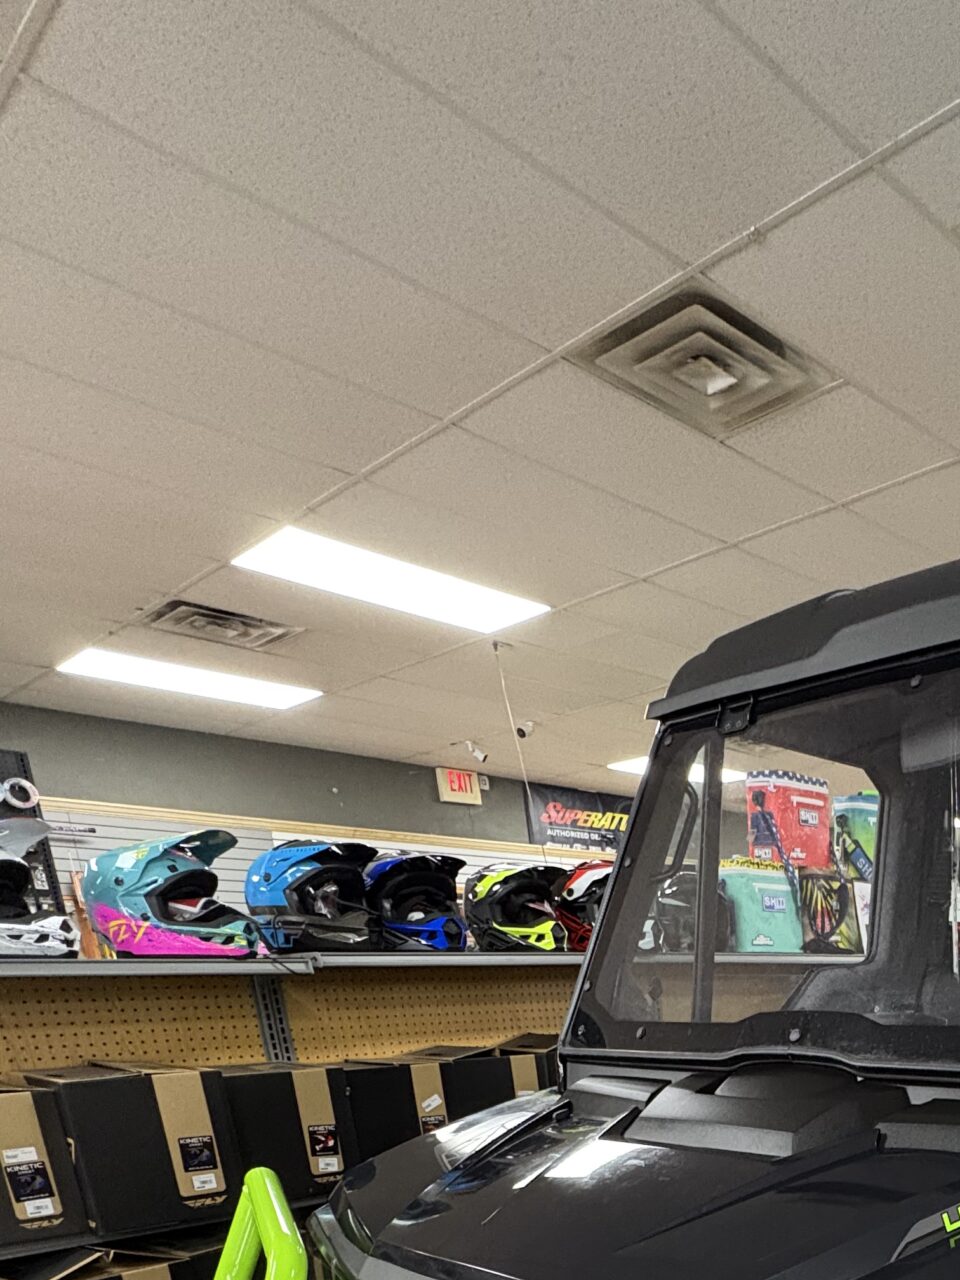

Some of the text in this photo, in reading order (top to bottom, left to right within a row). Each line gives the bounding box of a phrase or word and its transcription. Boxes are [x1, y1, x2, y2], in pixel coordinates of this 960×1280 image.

[447, 770, 473, 794] EXIT
[546, 828, 590, 840] AUTHORIZED
[108, 918, 150, 945] FLY
[179, 1136, 211, 1144] KINETIC
[6, 1161, 44, 1173] KINETIC
